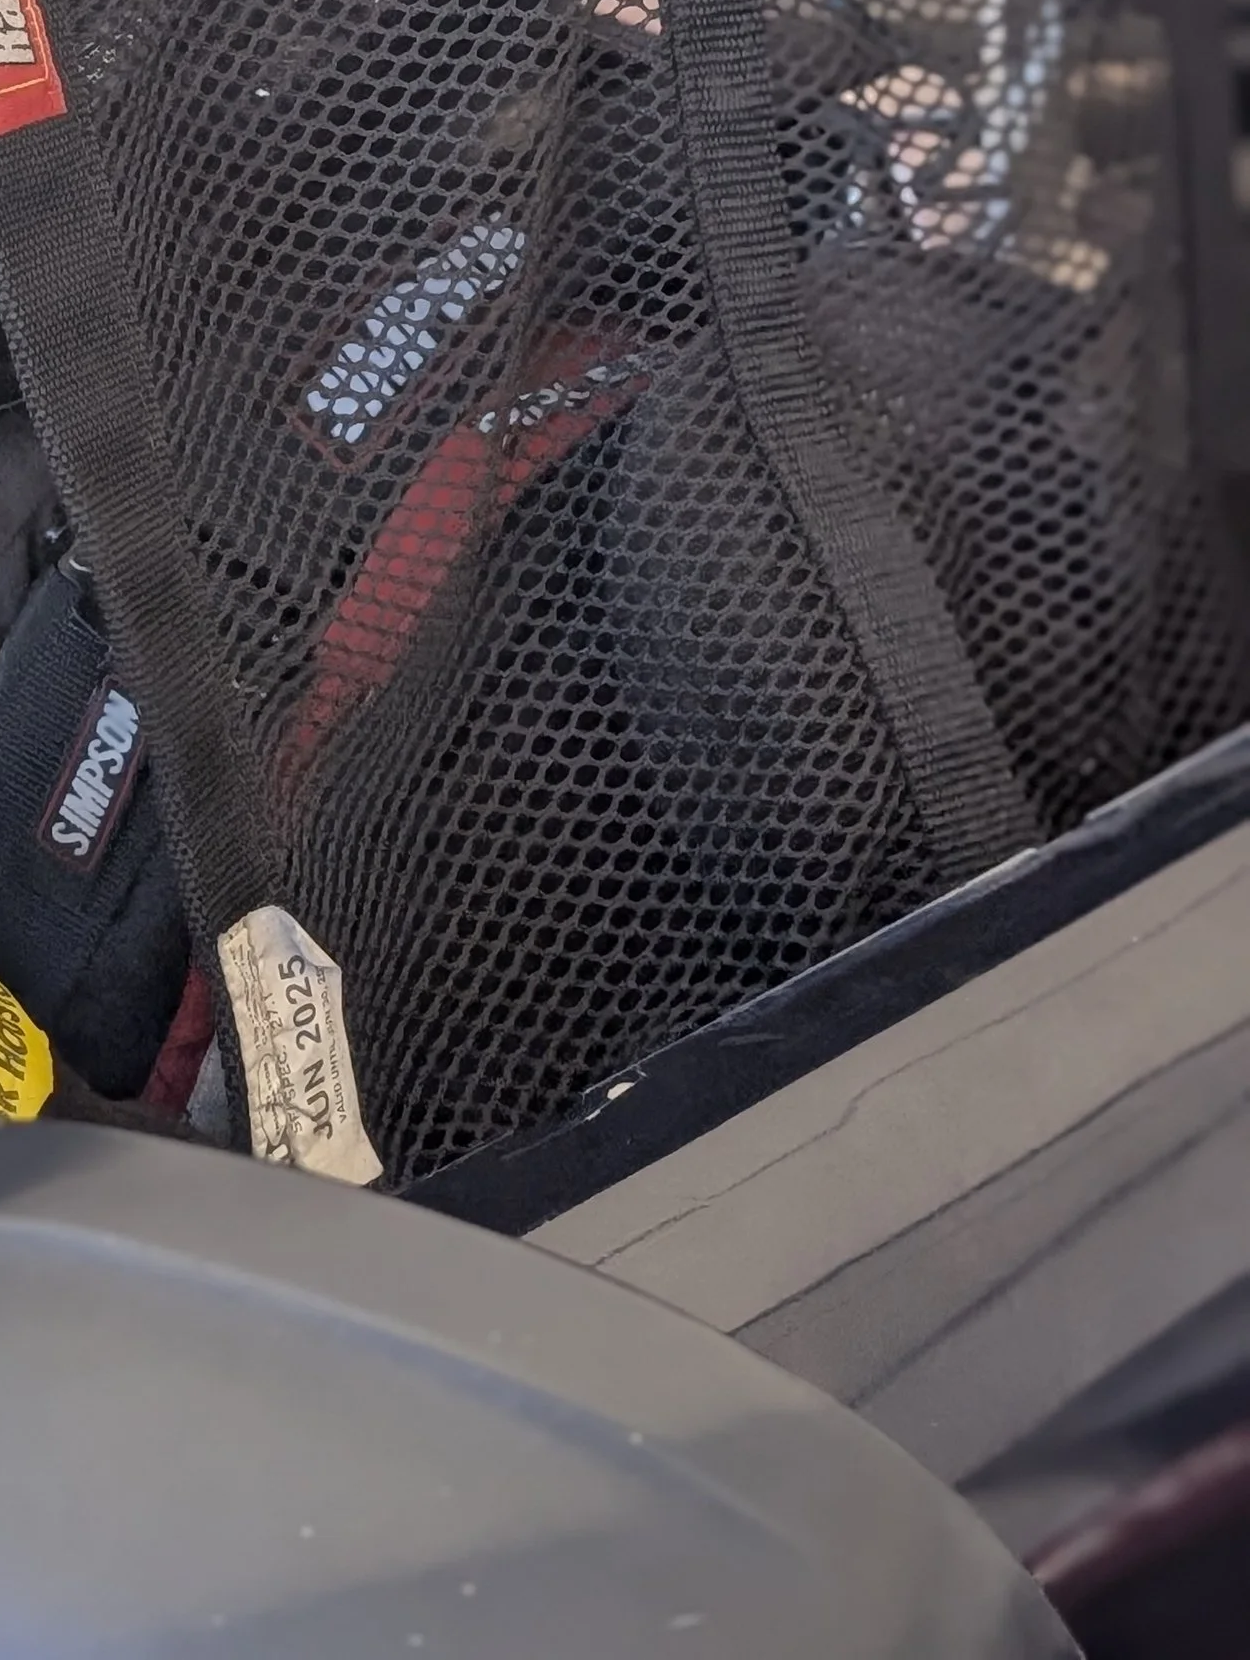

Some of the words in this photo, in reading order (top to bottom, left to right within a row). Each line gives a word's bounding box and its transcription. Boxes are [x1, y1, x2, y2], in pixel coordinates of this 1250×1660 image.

[52, 689, 140, 857] SIMPSON
[278, 954, 321, 1051] 2025
[303, 1058, 333, 1140] JUN
[333, 1082, 347, 1124] VALID
